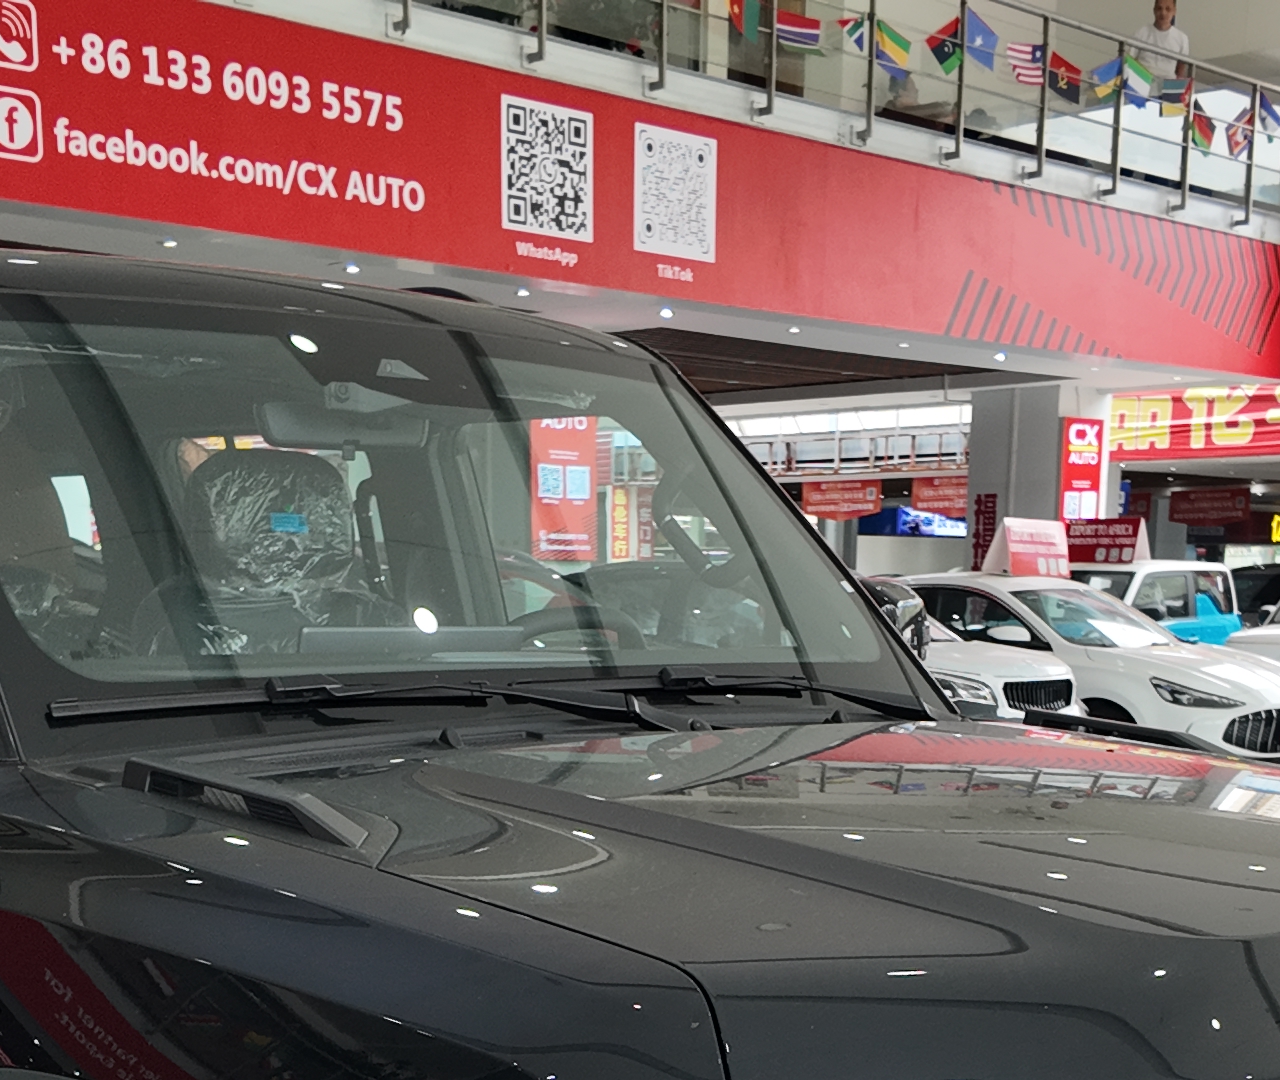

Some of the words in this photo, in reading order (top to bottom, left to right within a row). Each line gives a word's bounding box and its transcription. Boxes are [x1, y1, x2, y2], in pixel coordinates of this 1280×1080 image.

[52, 33, 131, 79] +86
[142, 45, 213, 95] 133
[222, 61, 312, 115] 6093
[322, 82, 404, 133] 5575
[54, 117, 338, 200] facebook.com/CX
[345, 169, 426, 213] AUTO
[516, 241, 578, 267] WhatsApp
[656, 264, 694, 282] TikTok
[1068, 423, 1099, 446] CX
[1068, 452, 1099, 465] AUTO
